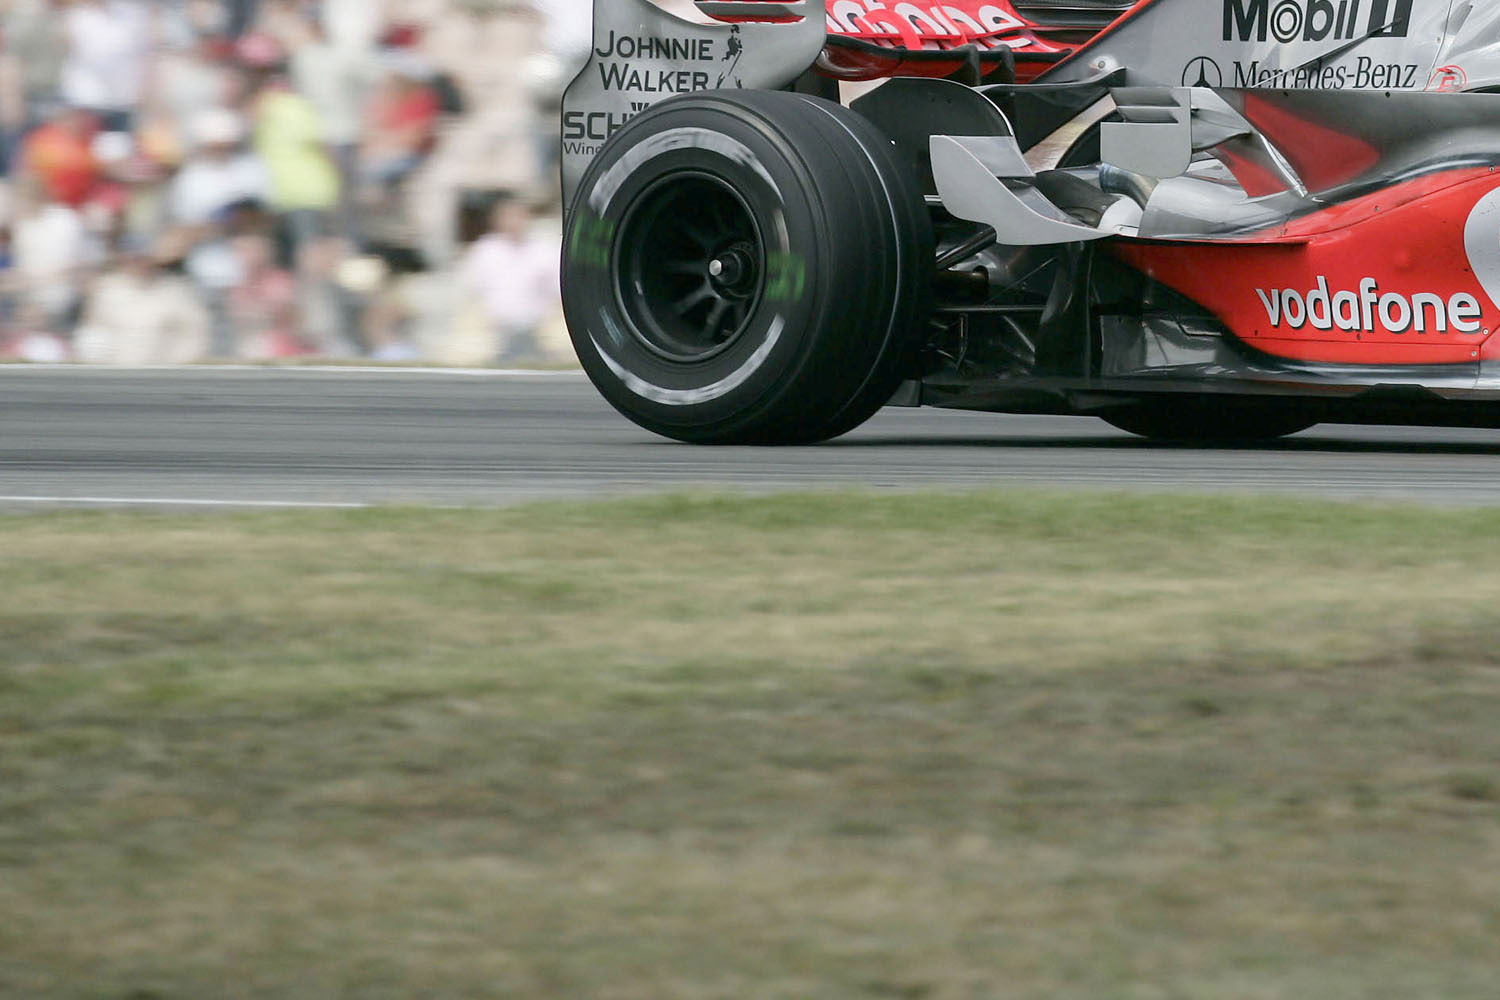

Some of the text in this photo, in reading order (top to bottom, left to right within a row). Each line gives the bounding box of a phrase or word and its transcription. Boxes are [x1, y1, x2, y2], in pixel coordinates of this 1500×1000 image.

[595, 30, 714, 61] JOHNNIE
[598, 62, 709, 93] WALKER
[1233, 56, 1418, 90] Mercedes-Benz
[564, 104, 646, 140] SCH
[1256, 276, 1481, 333] vodafone
